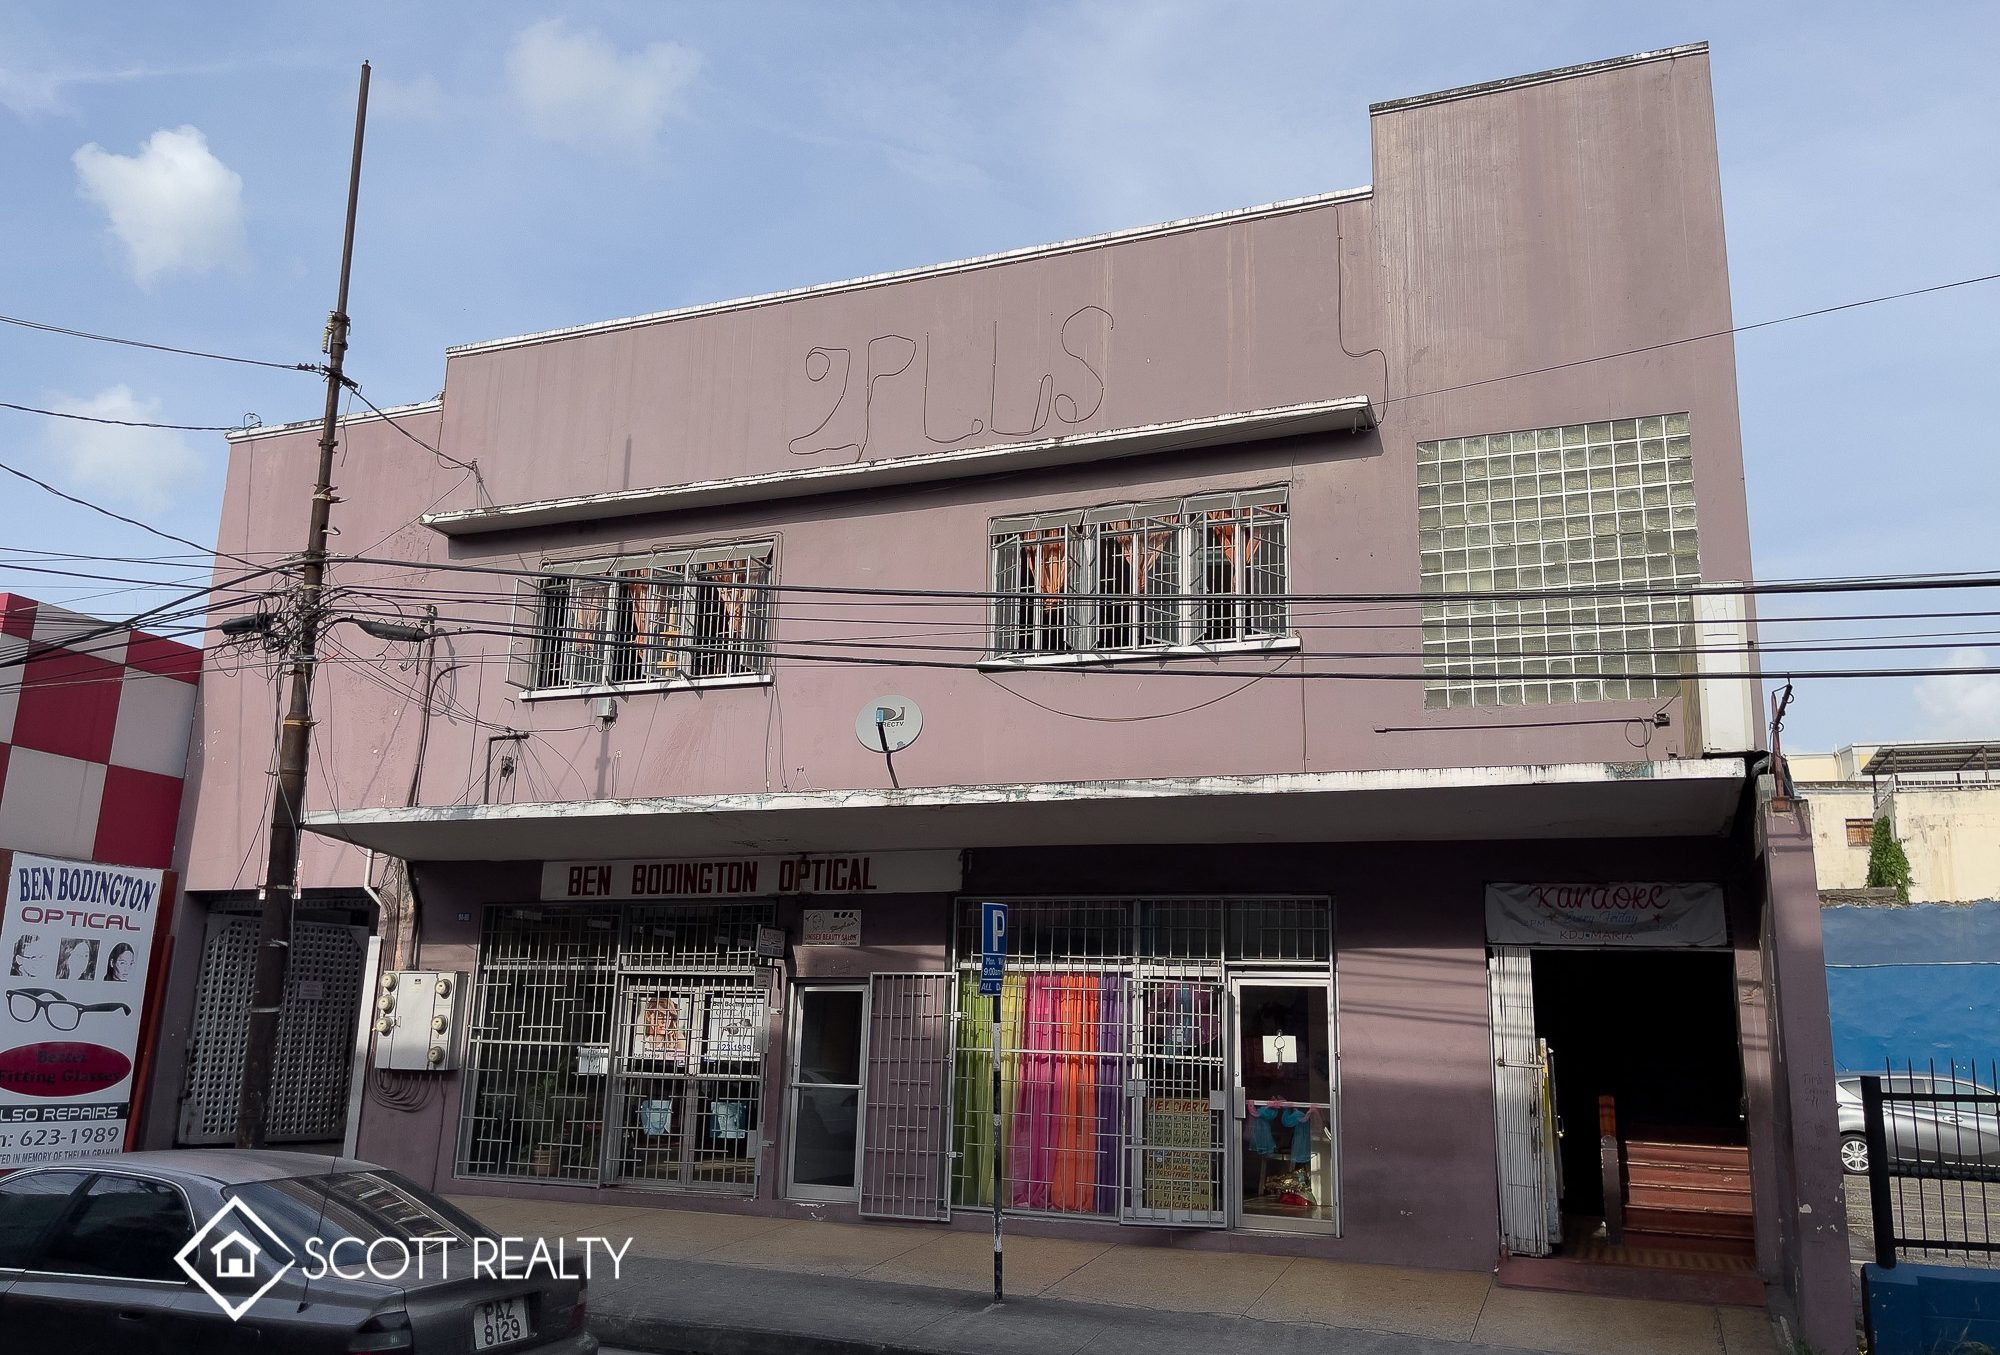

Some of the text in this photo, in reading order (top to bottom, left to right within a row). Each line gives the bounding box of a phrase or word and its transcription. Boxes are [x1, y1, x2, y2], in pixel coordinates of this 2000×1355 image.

[568, 858, 877, 896] BEN BODINGTON OPTICAL
[19, 867, 156, 913] BEN BODINGTON
[1528, 885, 1670, 909] Karaoke
[22, 906, 140, 931] OPTICAL
[993, 910, 1004, 951] P
[981, 982, 992, 991] ALL
[43, 1106, 118, 1120] REPAIRS
[20, 1127, 119, 1146] 623-1989
[22, 1152, 52, 1162] MEMORY
[53, 1151, 63, 1160] OF
[484, 1299, 515, 1324] PAZ
[484, 1319, 521, 1346] 8129
